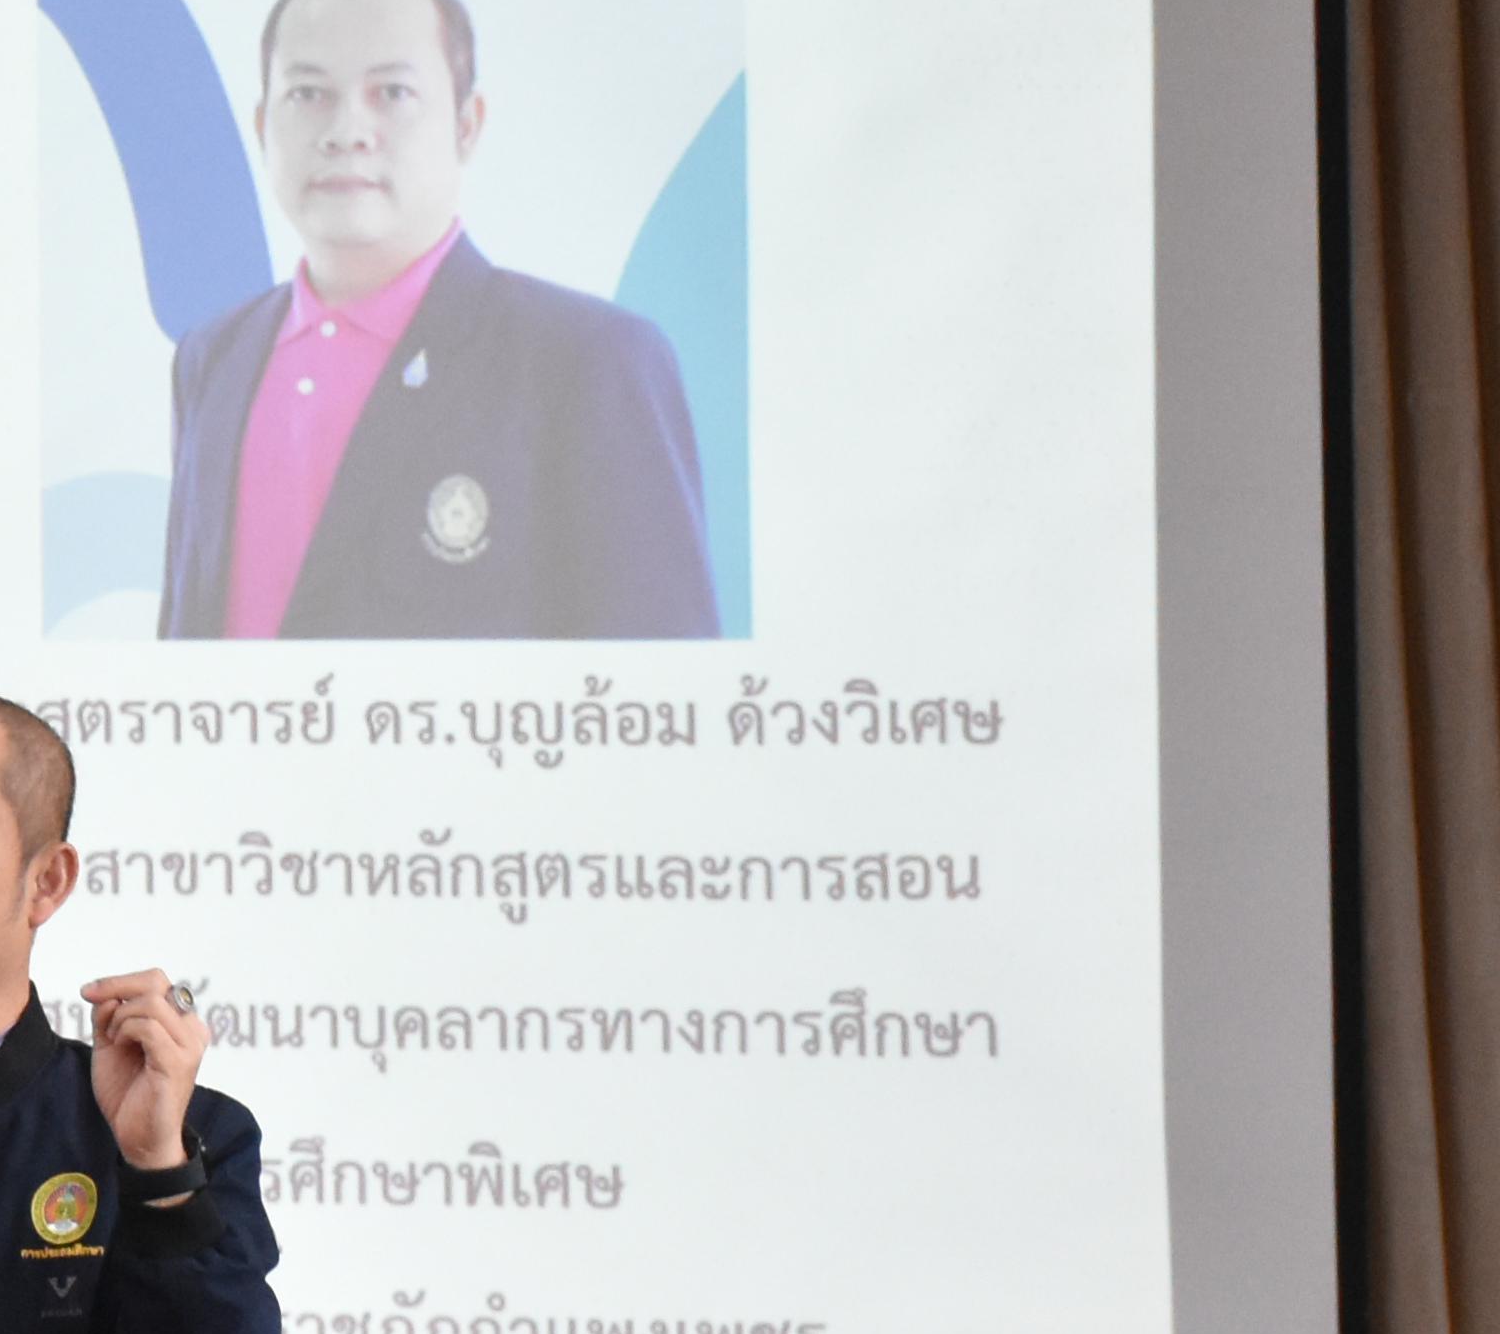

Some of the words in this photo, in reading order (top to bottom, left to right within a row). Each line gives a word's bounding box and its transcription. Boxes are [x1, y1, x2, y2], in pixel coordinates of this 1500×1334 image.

[726, 673, 1005, 748] ด้วงวิเศษ
[83, 827, 983, 926] สาขาวิชาหลักสูตรและการสอน
[261, 1135, 627, 1211] รศึกษาพิเศษ
